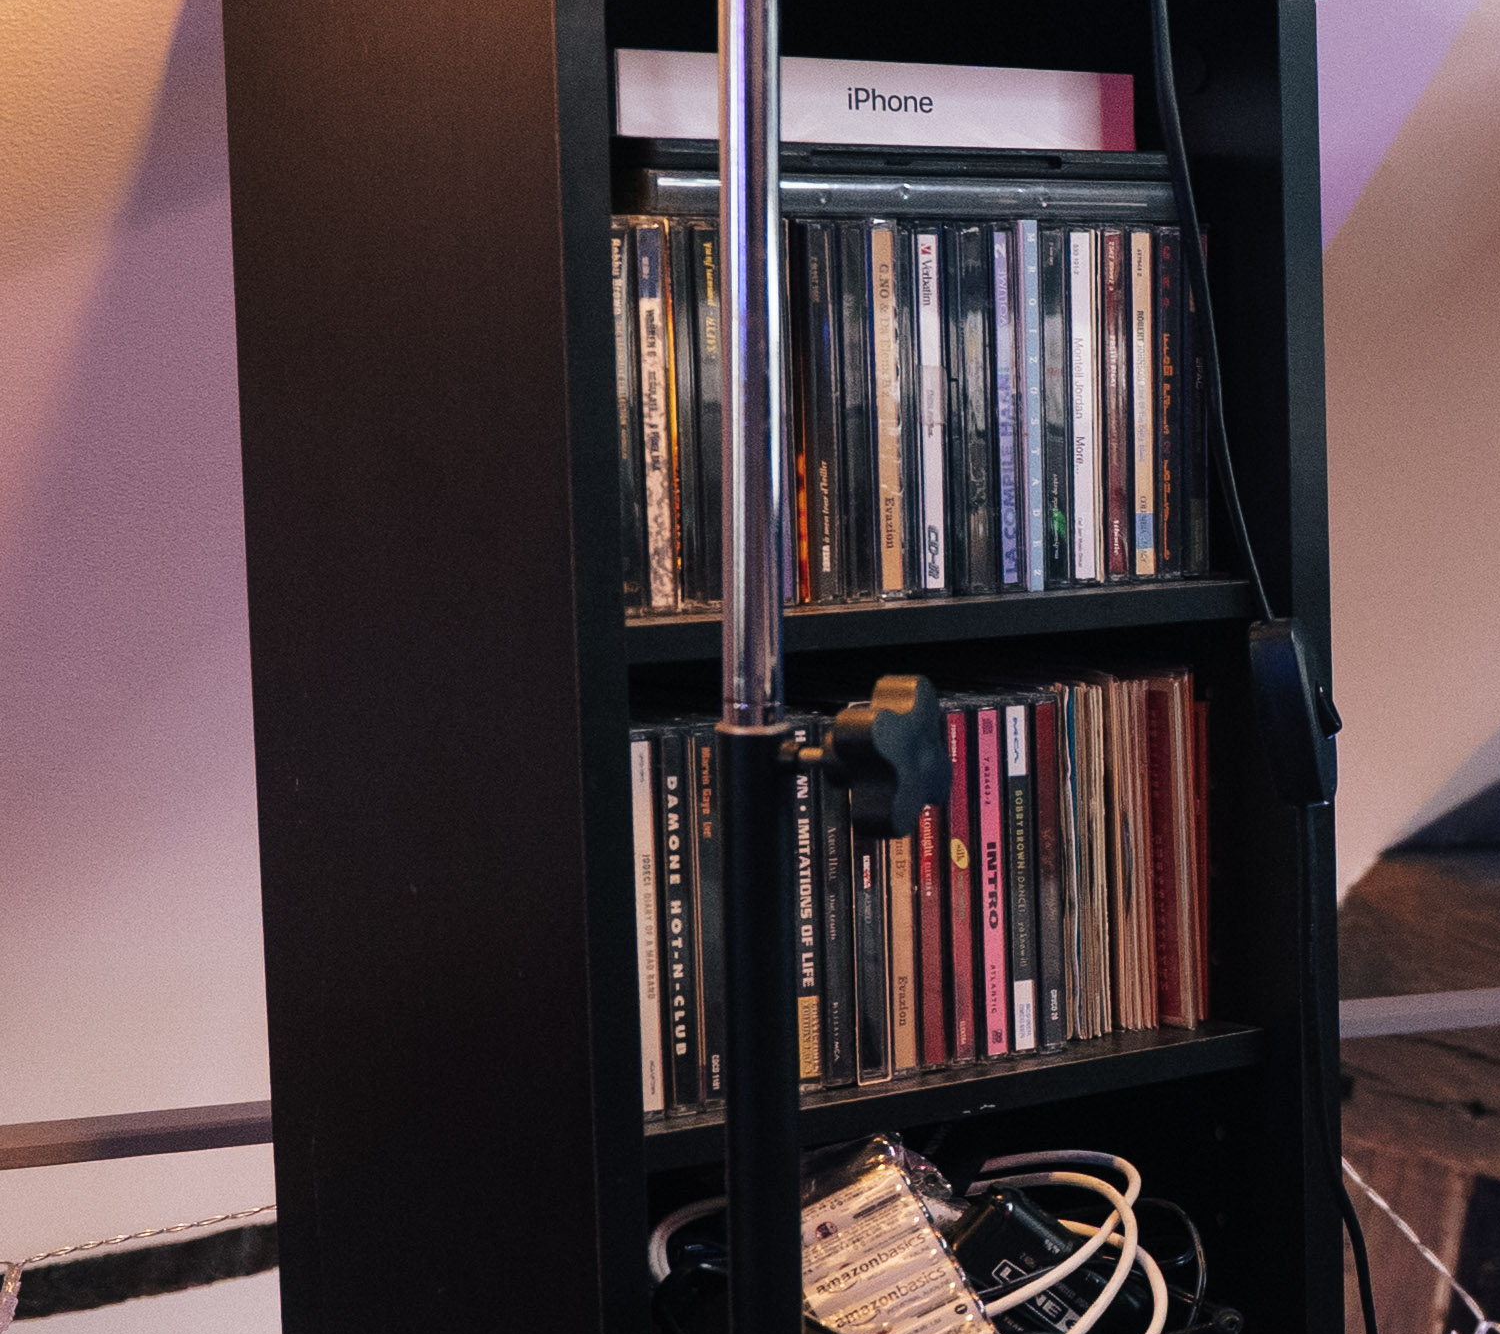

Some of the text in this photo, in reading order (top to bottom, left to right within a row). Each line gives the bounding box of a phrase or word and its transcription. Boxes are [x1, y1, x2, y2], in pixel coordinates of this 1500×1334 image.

[847, 86, 935, 115] iPhone
[994, 243, 1007, 259] 2
[879, 263, 890, 299] G.NO
[921, 260, 933, 306] Verbatim
[1136, 310, 1145, 342] ROBERT
[1074, 338, 1086, 475] Montell Jordan More...
[926, 525, 940, 579] CD-R
[701, 747, 712, 785] Marvin
[701, 788, 712, 815] Gaye
[1015, 789, 1024, 827] BOBBY
[921, 817, 934, 857] tonight
[956, 844, 965, 862] silk
[797, 818, 815, 987] IMITATIONS OF LIFE
[986, 841, 999, 930] INTRO
[667, 775, 688, 1057] DAMONE HOT-N-CLUB
[815, 1232, 927, 1295] amazonbasics
[835, 1266, 947, 1329] amazonbasics
